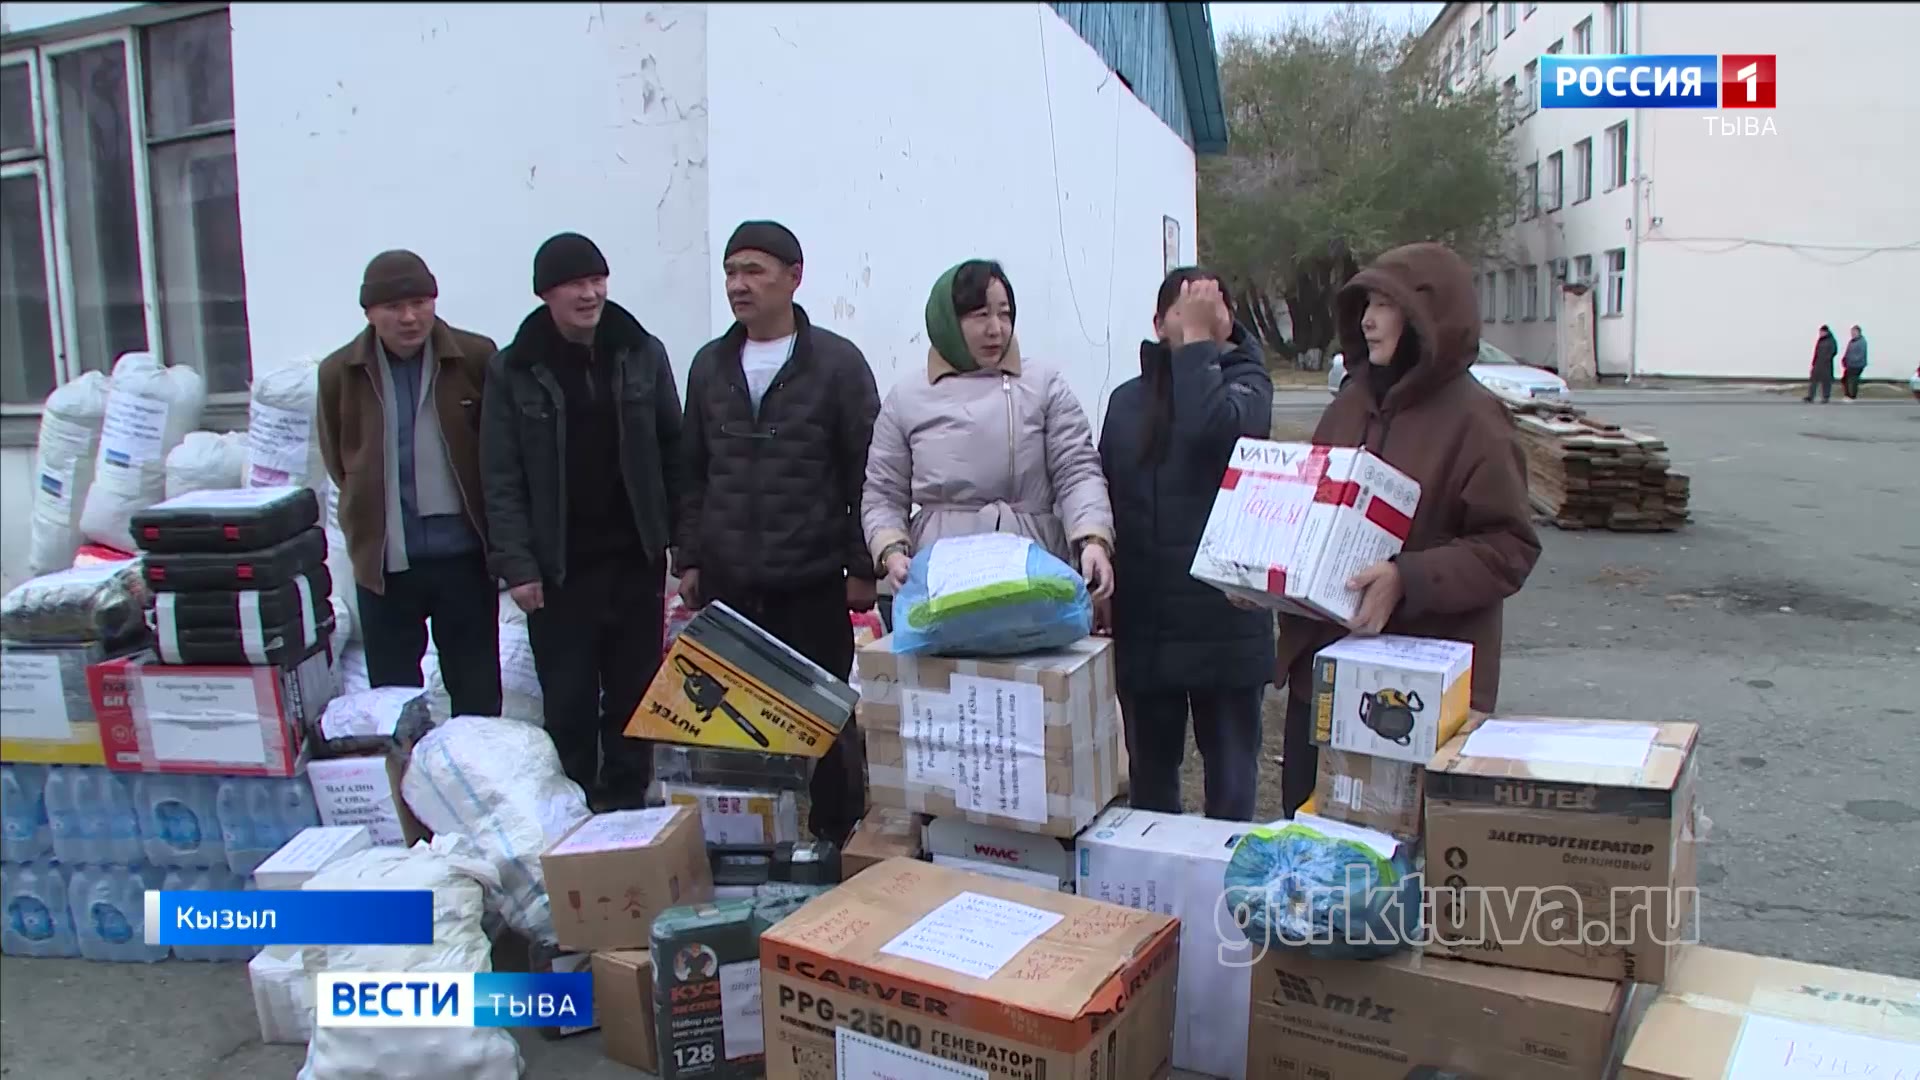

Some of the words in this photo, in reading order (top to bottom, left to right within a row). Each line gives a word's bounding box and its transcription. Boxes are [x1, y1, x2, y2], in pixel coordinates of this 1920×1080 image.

[973, 843, 1019, 862] WMC
[1488, 829, 1654, 856] ЭЛЕКТРОГЕНЕРАТОР
[1562, 851, 1653, 872] бензиновый
[795, 960, 951, 1017] CARVER
[778, 984, 922, 1049] PPG-2500
[1323, 990, 1395, 1023] mtx
[673, 1043, 715, 1067] 128
[930, 1029, 1034, 1068] ГЕНЕРАТОР
